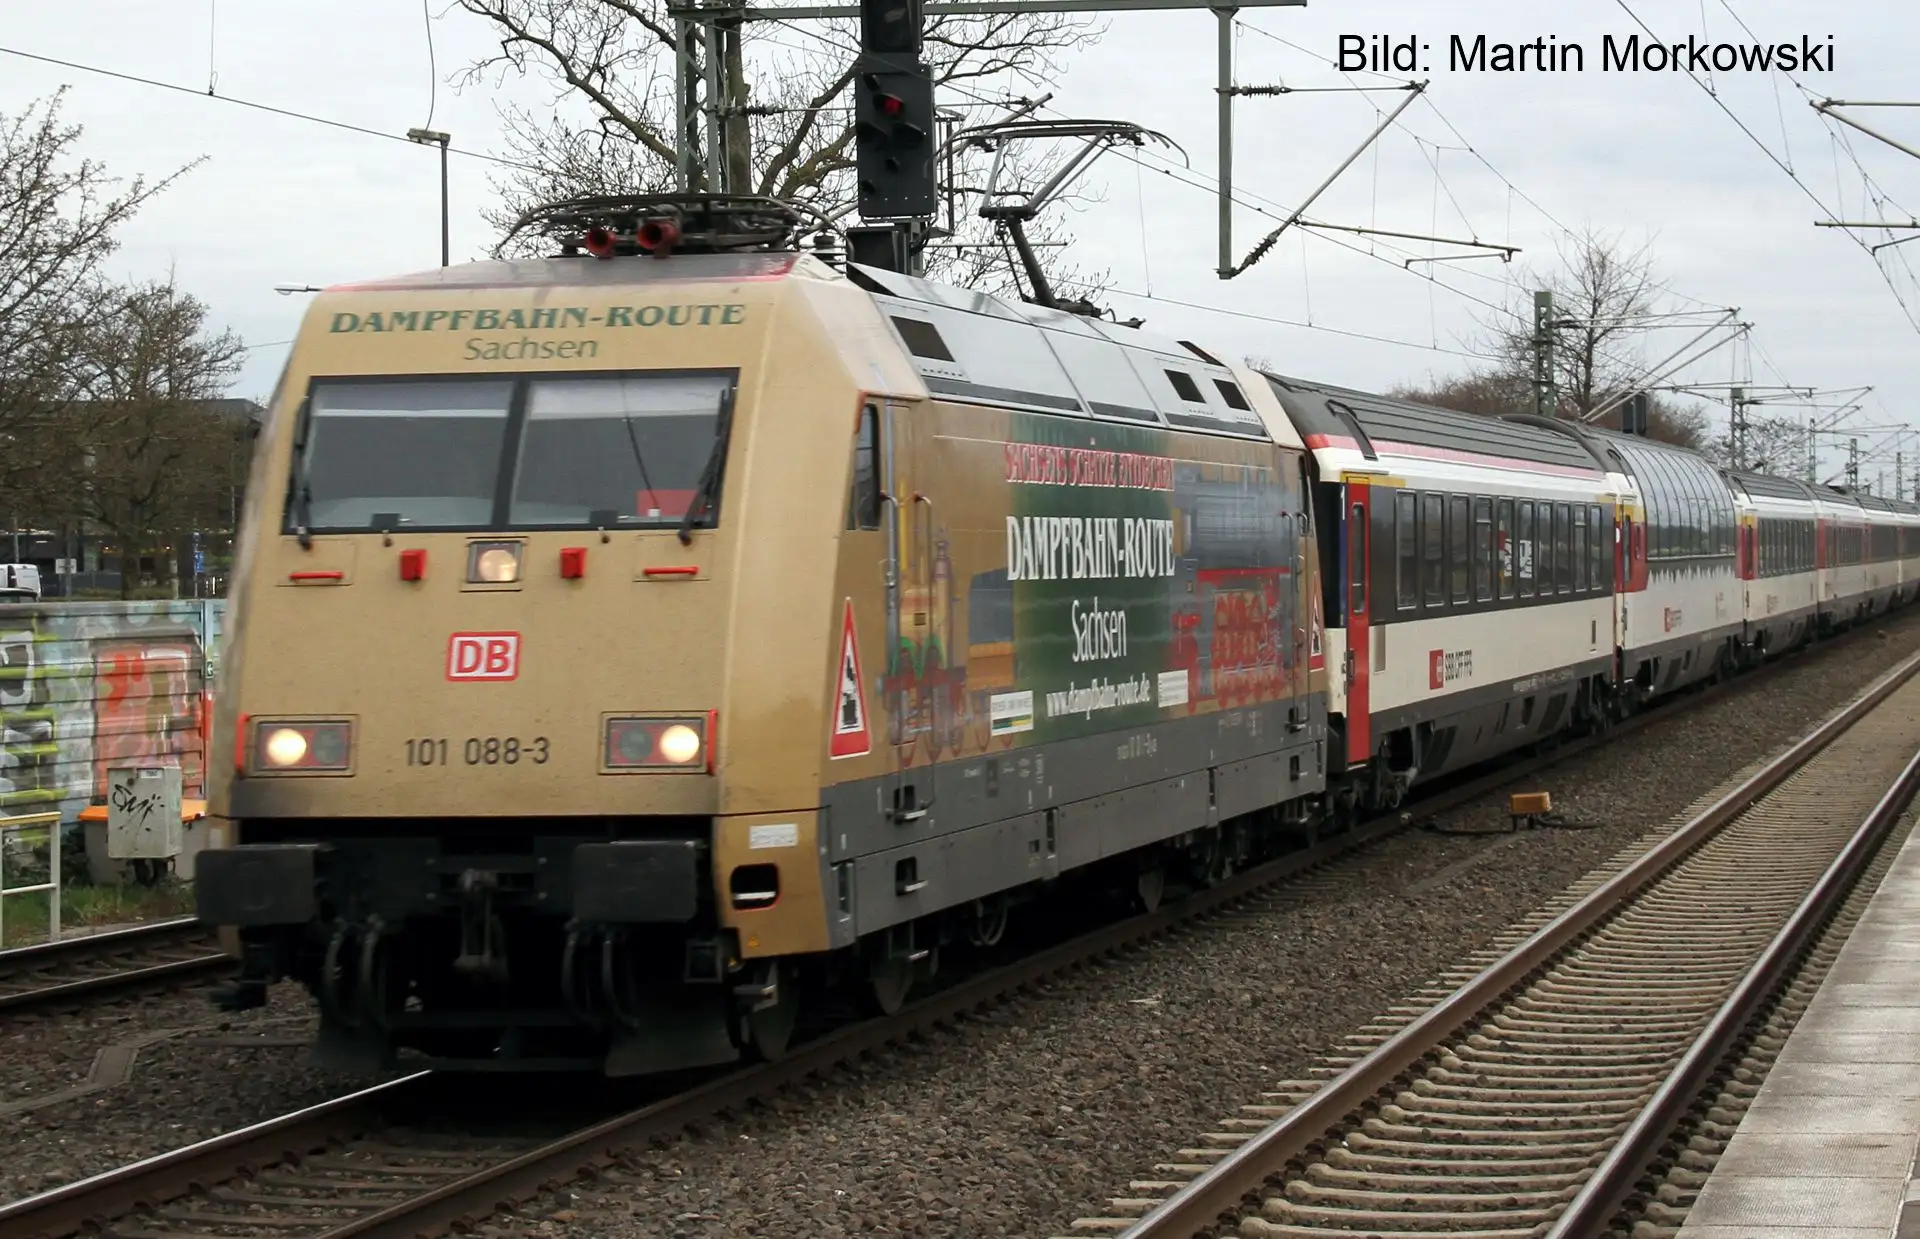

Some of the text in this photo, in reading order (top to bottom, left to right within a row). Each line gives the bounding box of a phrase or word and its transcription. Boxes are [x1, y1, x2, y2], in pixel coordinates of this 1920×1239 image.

[329, 304, 746, 334] DAMPFBAHN-ROUTE
[463, 336, 599, 362] Sachsen
[1340, 485, 1346, 521] 1
[1006, 515, 1176, 581] DAMPFBAHN-ROUTE
[1071, 596, 1127, 662] Sachsen
[455, 639, 511, 674] DB
[405, 736, 549, 766] 101 088-3
